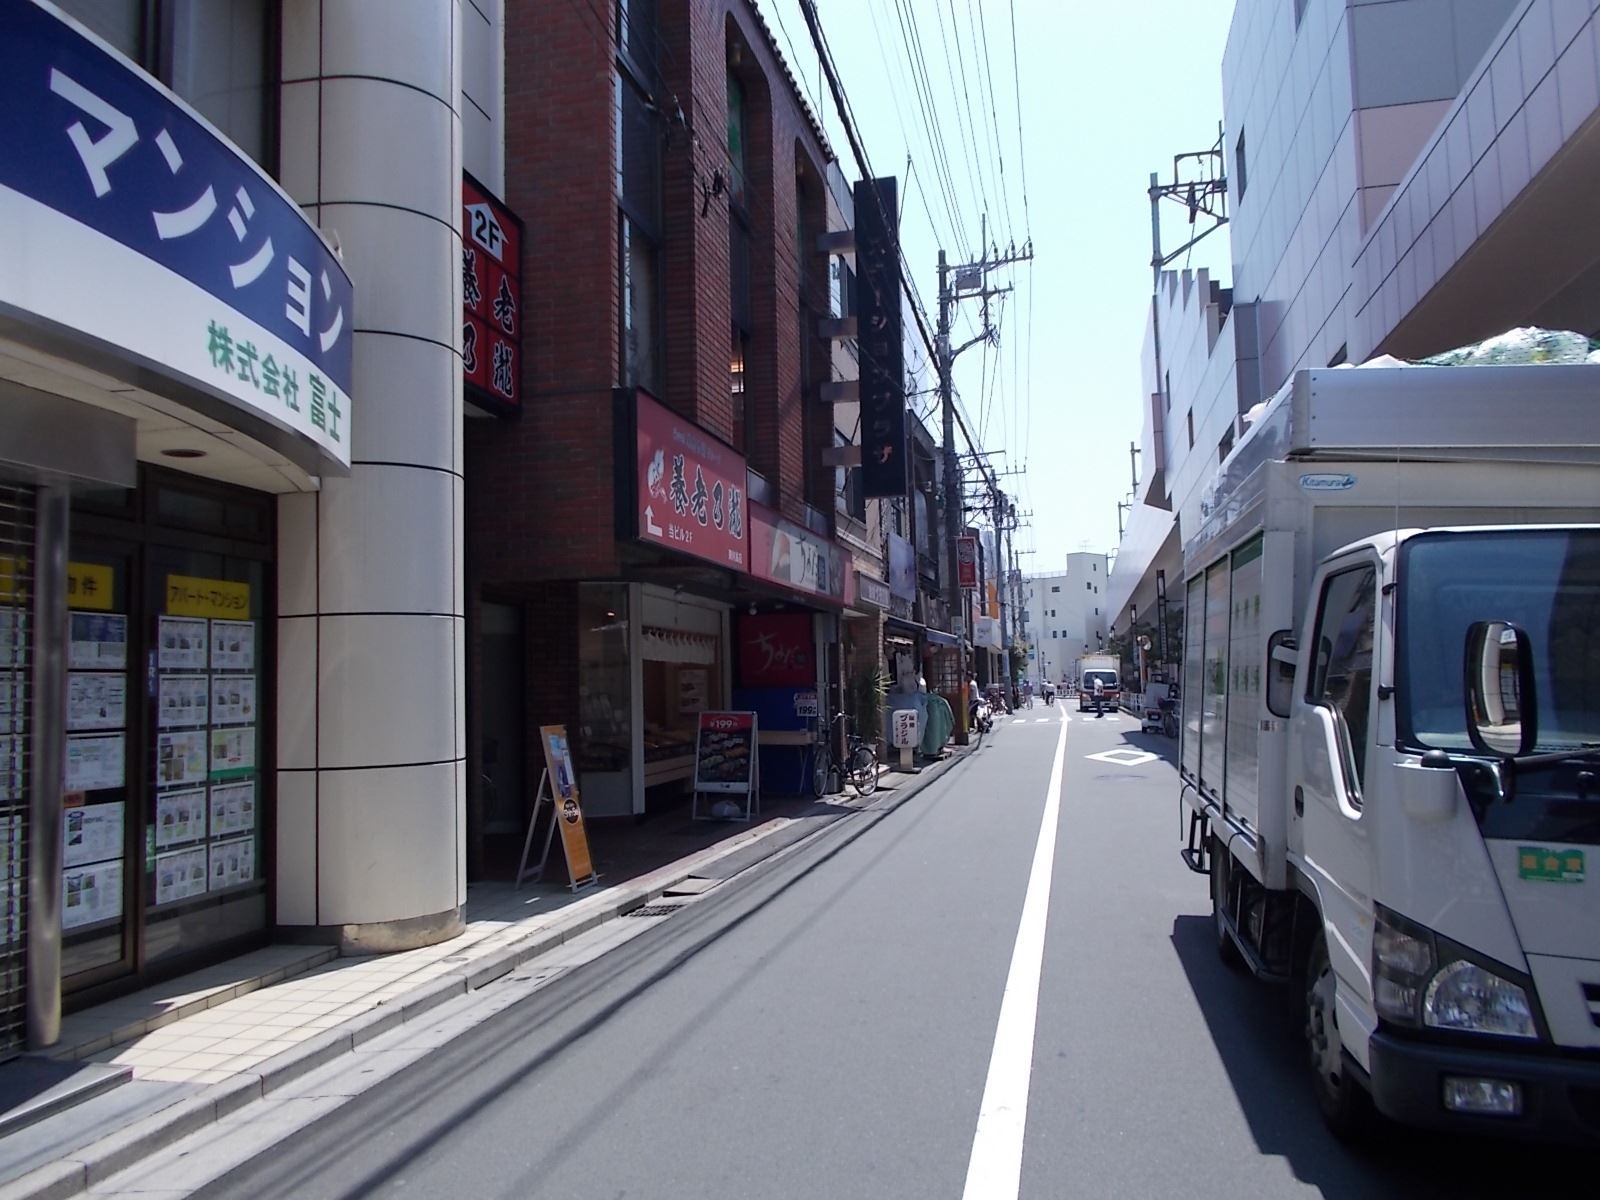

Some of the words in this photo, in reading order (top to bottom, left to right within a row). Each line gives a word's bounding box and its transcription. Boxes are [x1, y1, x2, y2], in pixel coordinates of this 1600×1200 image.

[49, 67, 344, 353] マンション
[474, 209, 500, 250] 2F
[208, 319, 300, 414] 株式会社
[309, 374, 342, 442] 富士
